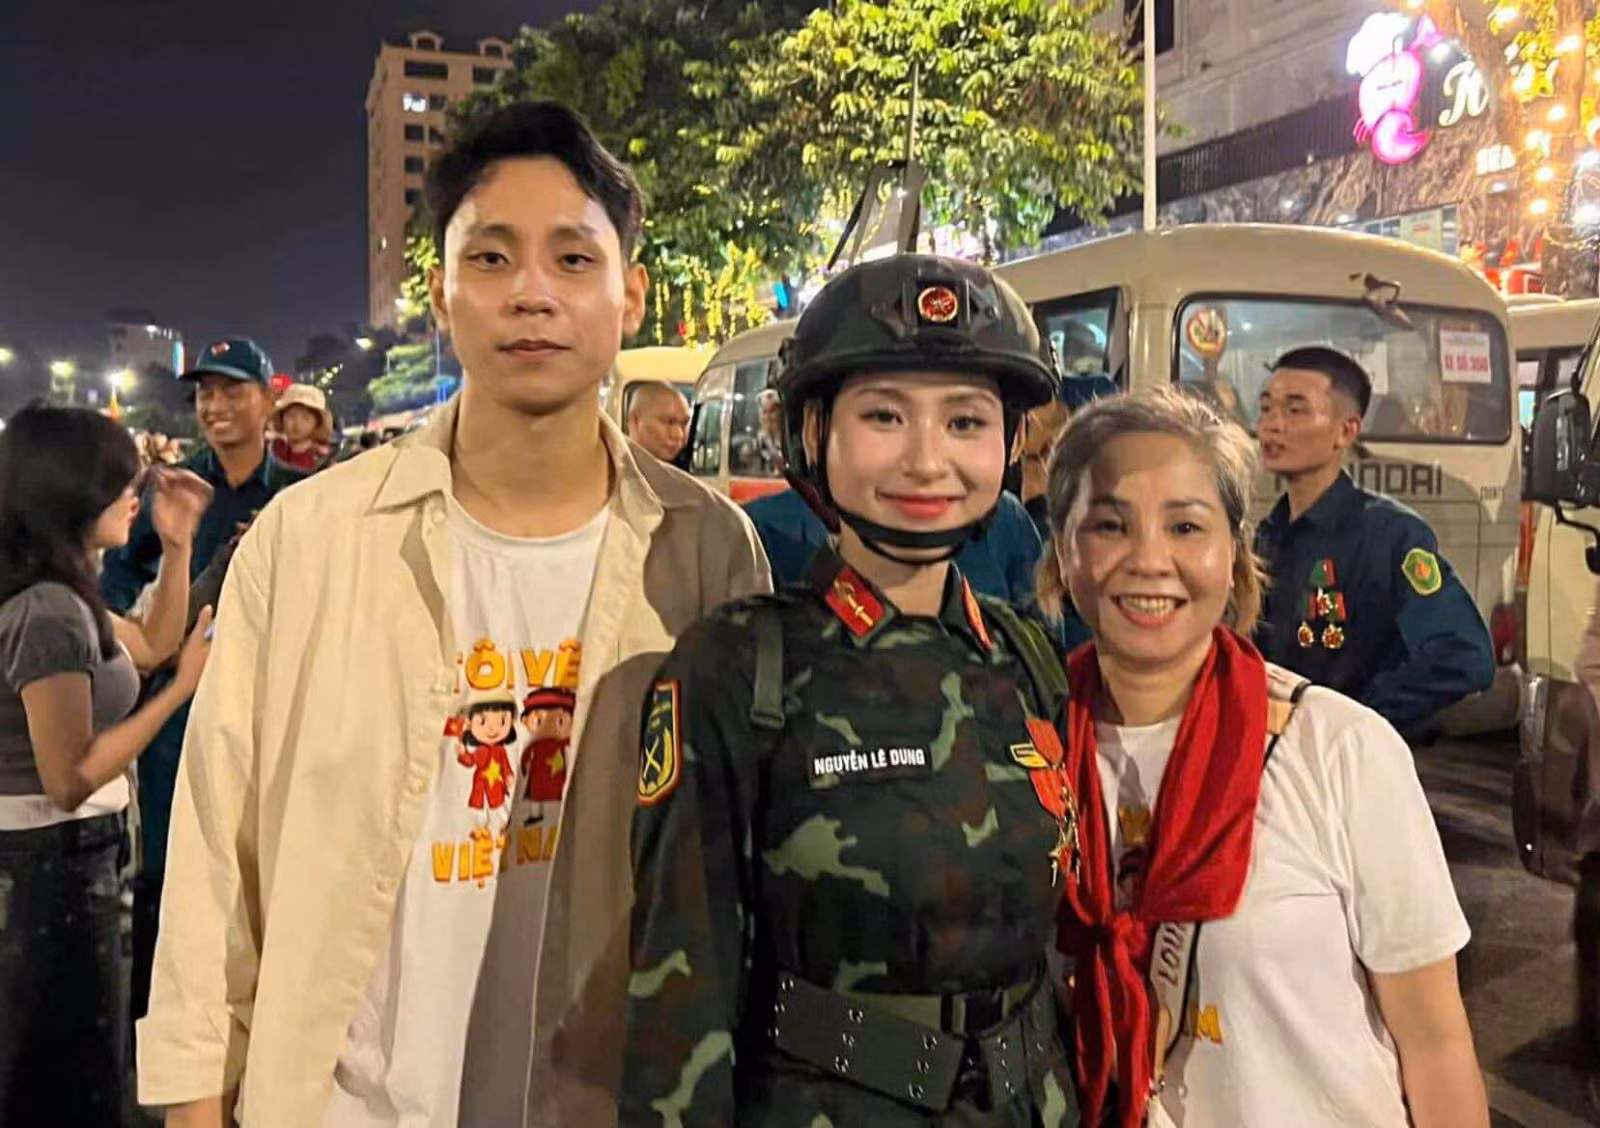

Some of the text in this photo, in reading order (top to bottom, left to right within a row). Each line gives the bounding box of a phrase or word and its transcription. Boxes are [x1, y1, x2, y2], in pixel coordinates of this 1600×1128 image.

[454, 638, 515, 694] ÔI
[870, 747, 888, 769] LÊ
[888, 746, 926, 767] DUNG
